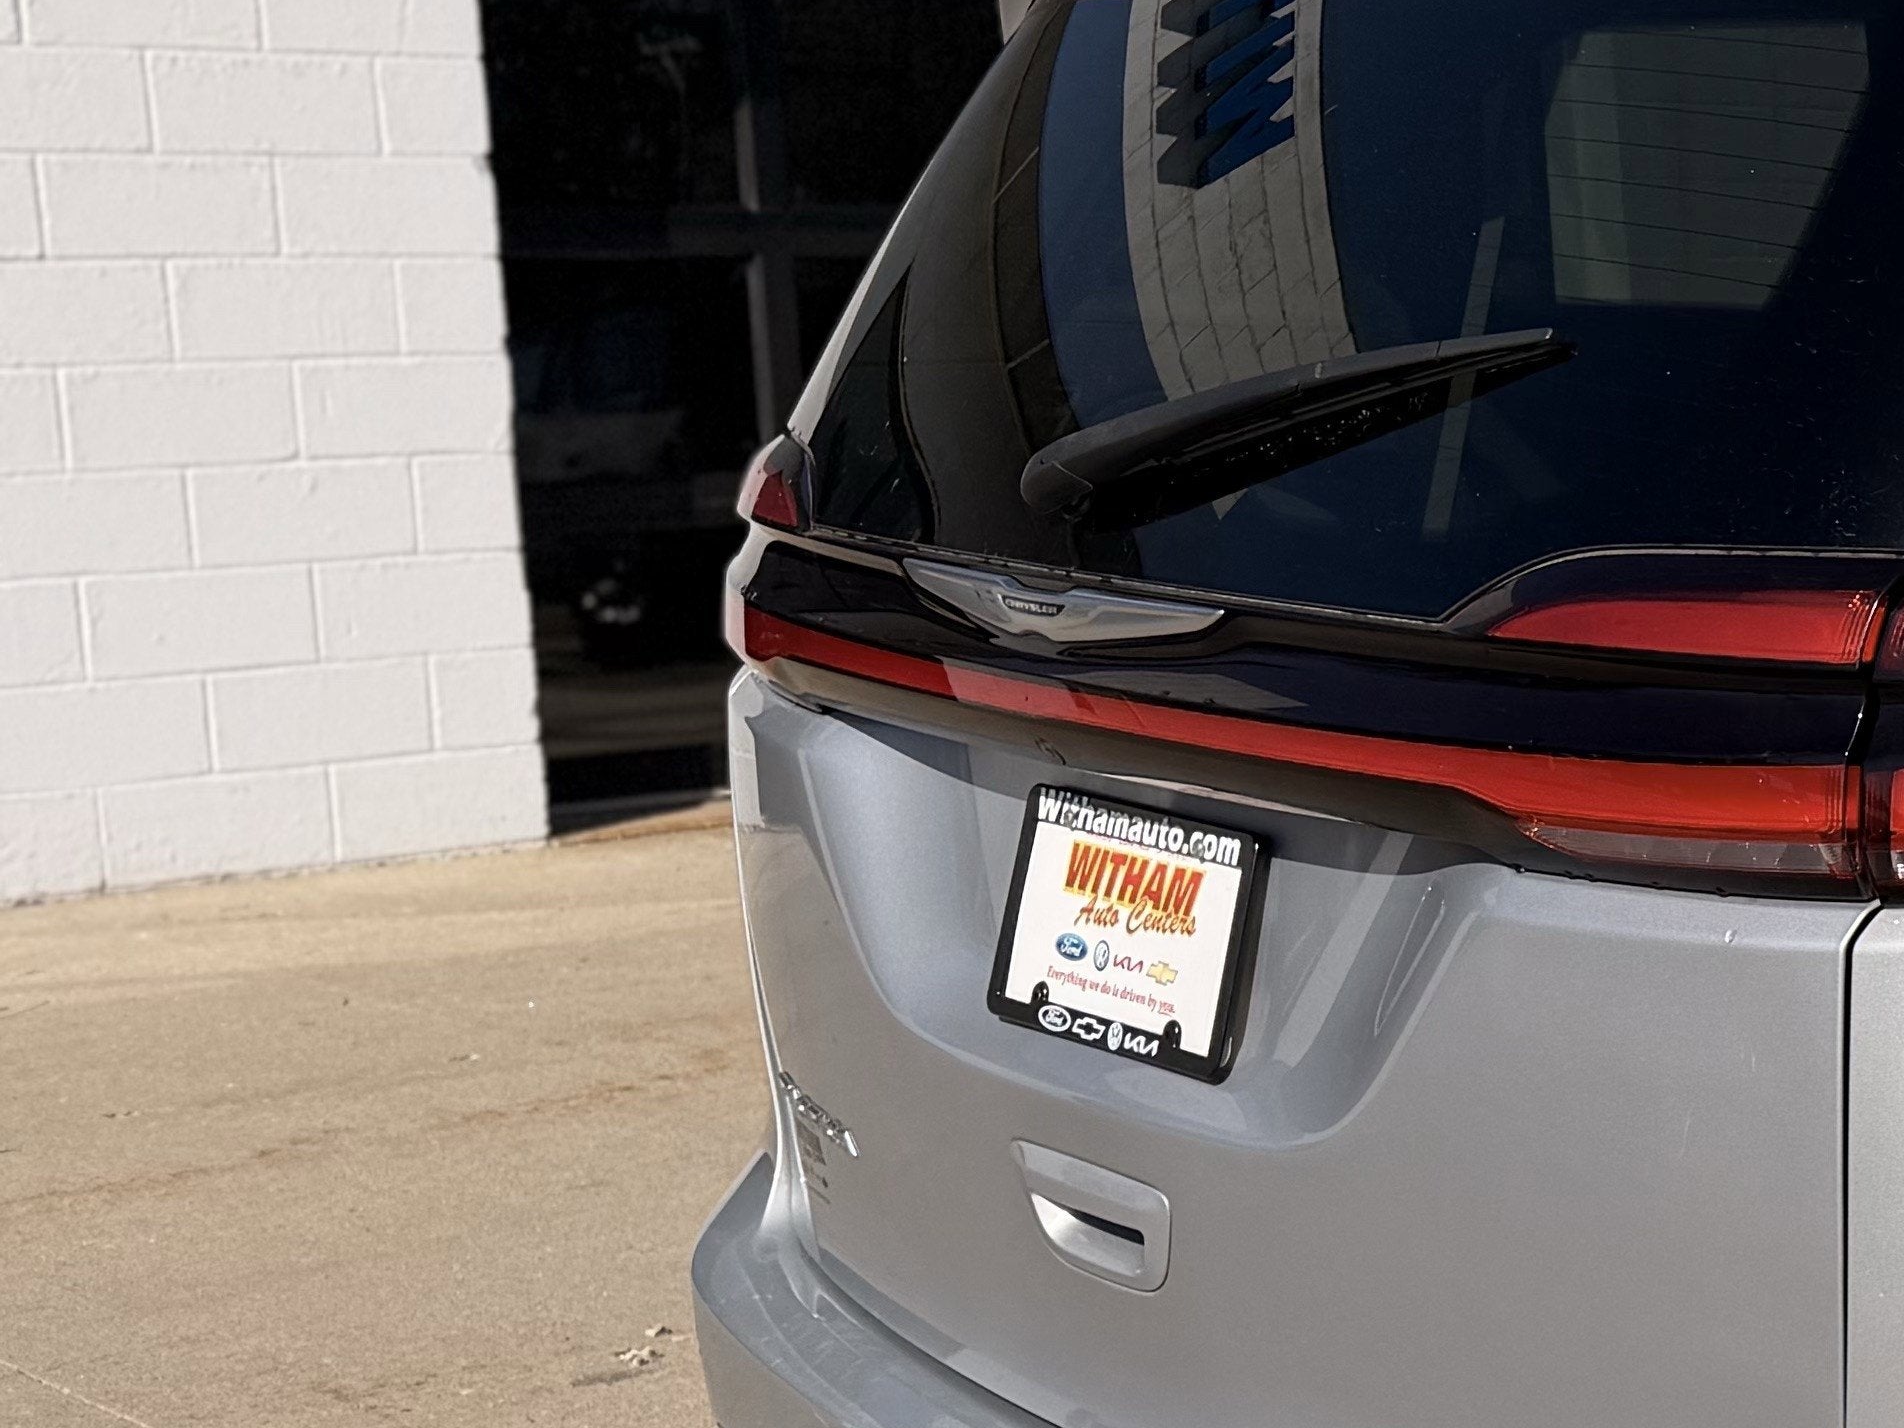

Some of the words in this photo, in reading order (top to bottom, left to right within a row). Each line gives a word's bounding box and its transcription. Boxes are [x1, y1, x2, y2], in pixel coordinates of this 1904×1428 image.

[1004, 598, 1058, 614] CHRYSLER
[1063, 840, 1207, 918] WITHAM
[1073, 895, 1119, 928] Auto
[1125, 901, 1198, 938] Centers
[1059, 935, 1085, 958] Ford
[1101, 981, 1111, 995] do
